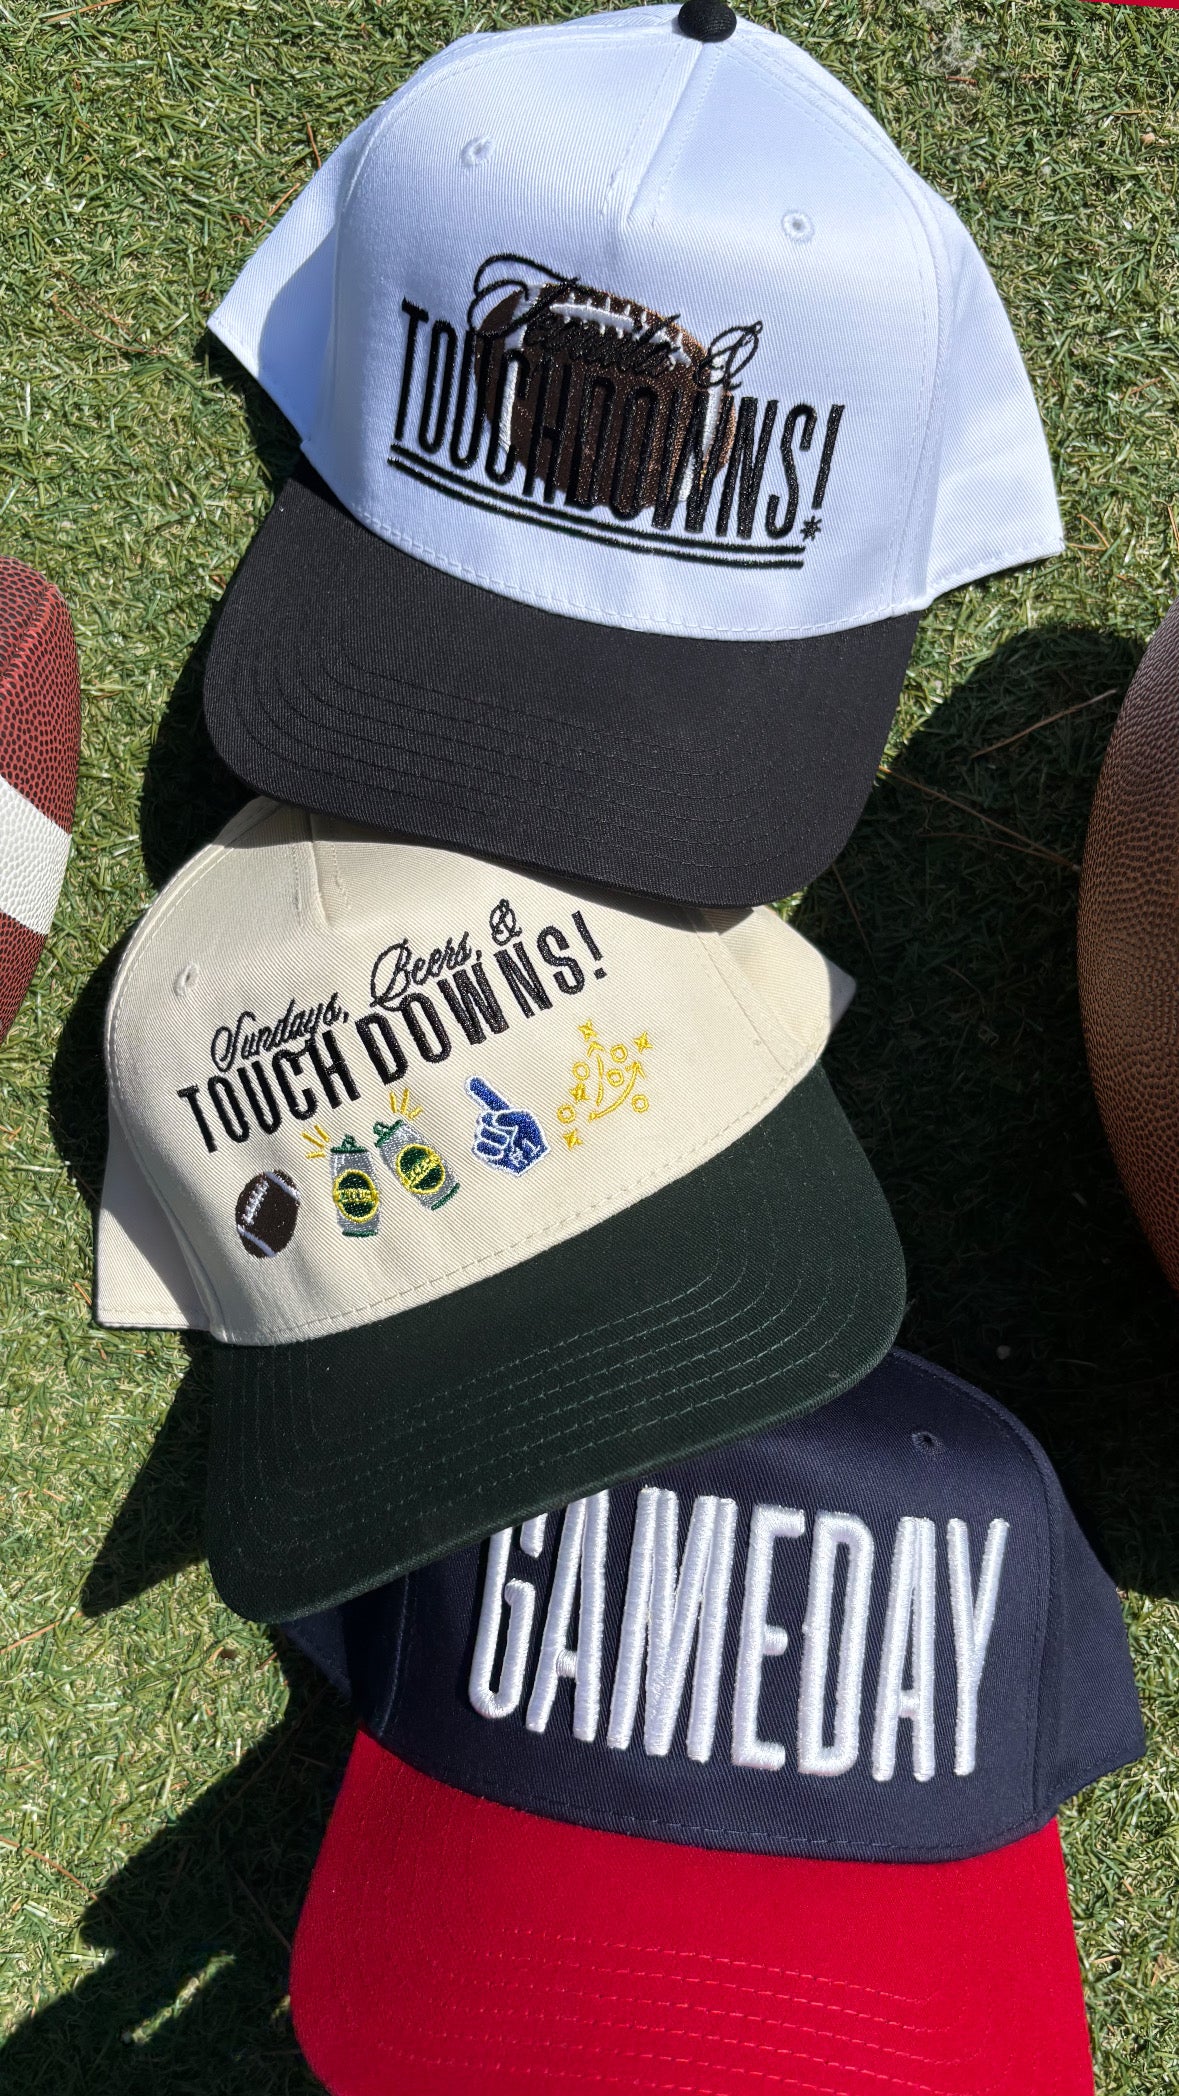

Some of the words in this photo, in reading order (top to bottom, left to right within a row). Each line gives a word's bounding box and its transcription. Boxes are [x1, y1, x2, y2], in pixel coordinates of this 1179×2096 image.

[393, 296, 846, 542] TOUCHDOWNS!
[692, 320, 765, 392] &
[210, 991, 351, 1073] Sundays,
[369, 930, 483, 1012] Beers,
[488, 898, 523, 946] &
[468, 1485, 1011, 1782] GAMEDAY
